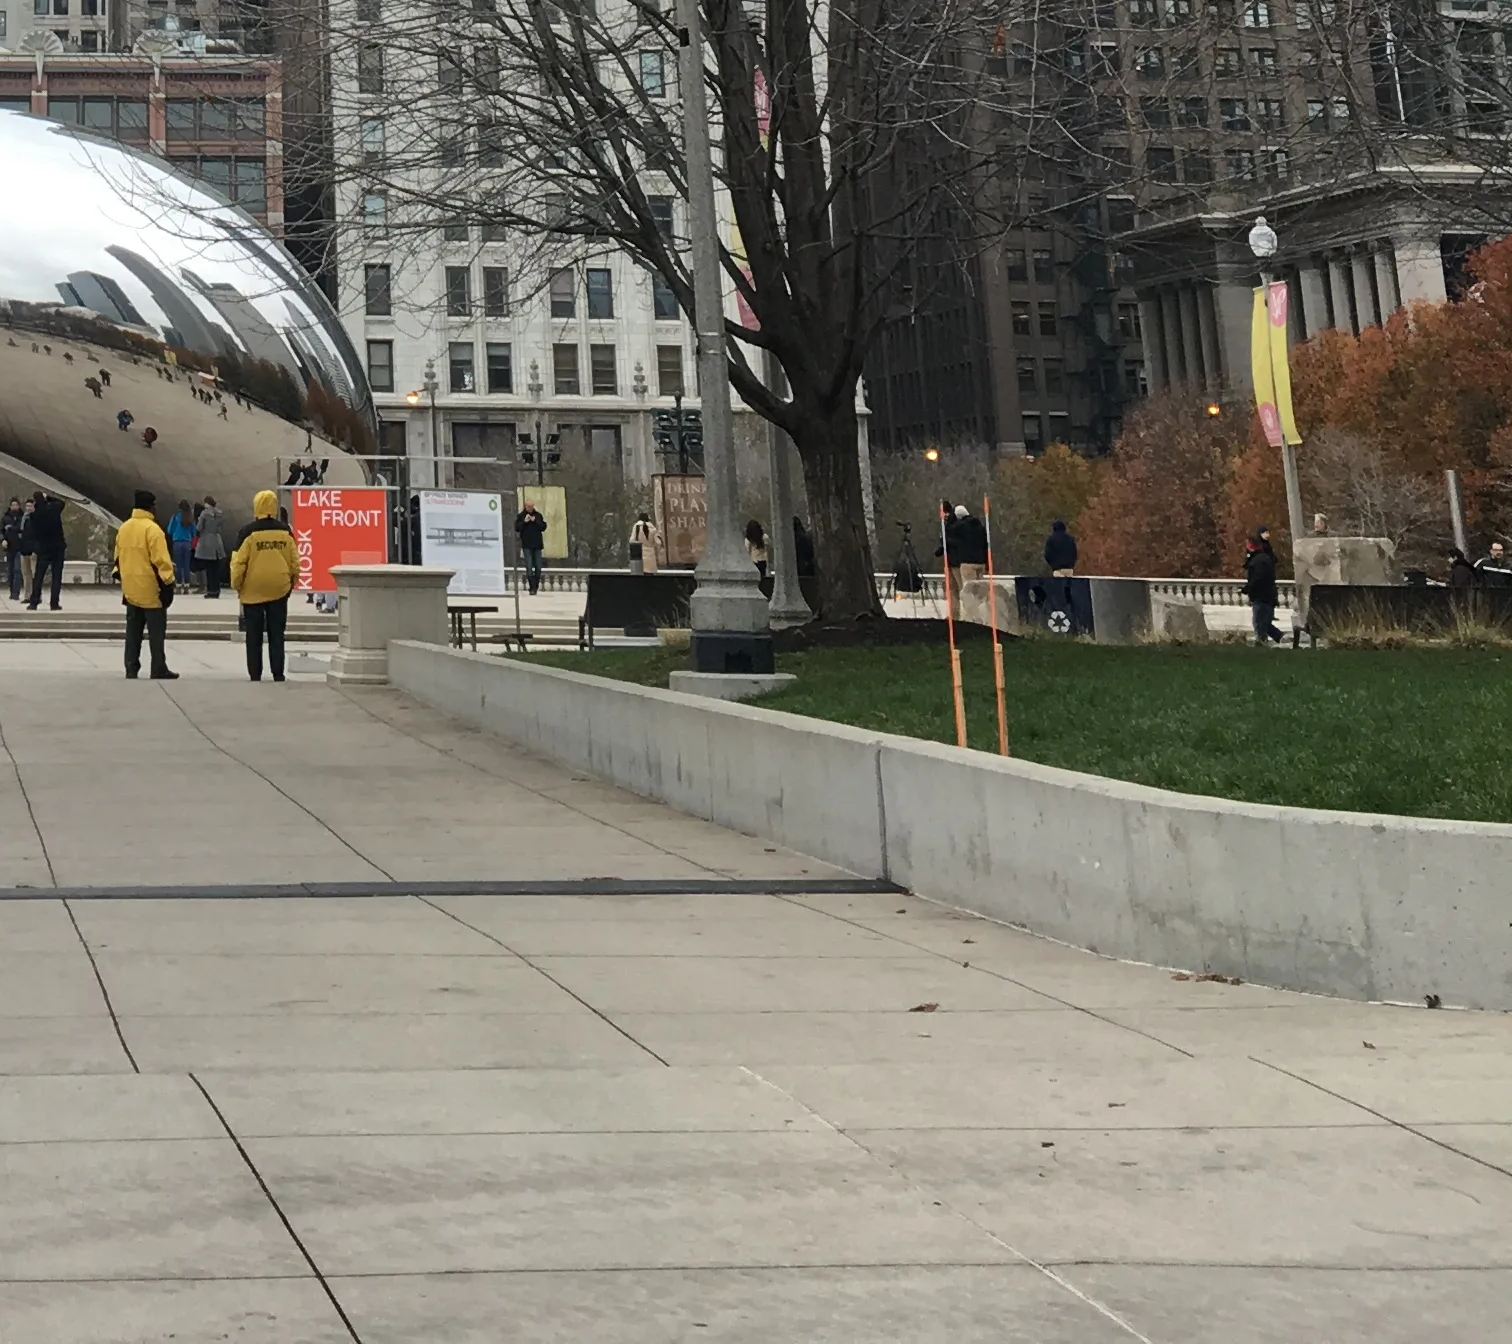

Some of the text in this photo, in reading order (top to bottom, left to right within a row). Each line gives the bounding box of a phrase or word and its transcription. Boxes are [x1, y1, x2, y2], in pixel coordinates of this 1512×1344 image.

[297, 490, 342, 507] LAKE
[670, 498, 708, 512] PLAY
[321, 509, 382, 527] FRONT
[669, 516, 707, 529] SHAR
[256, 540, 287, 551] SECURITY
[297, 529, 313, 590] KIOSK
